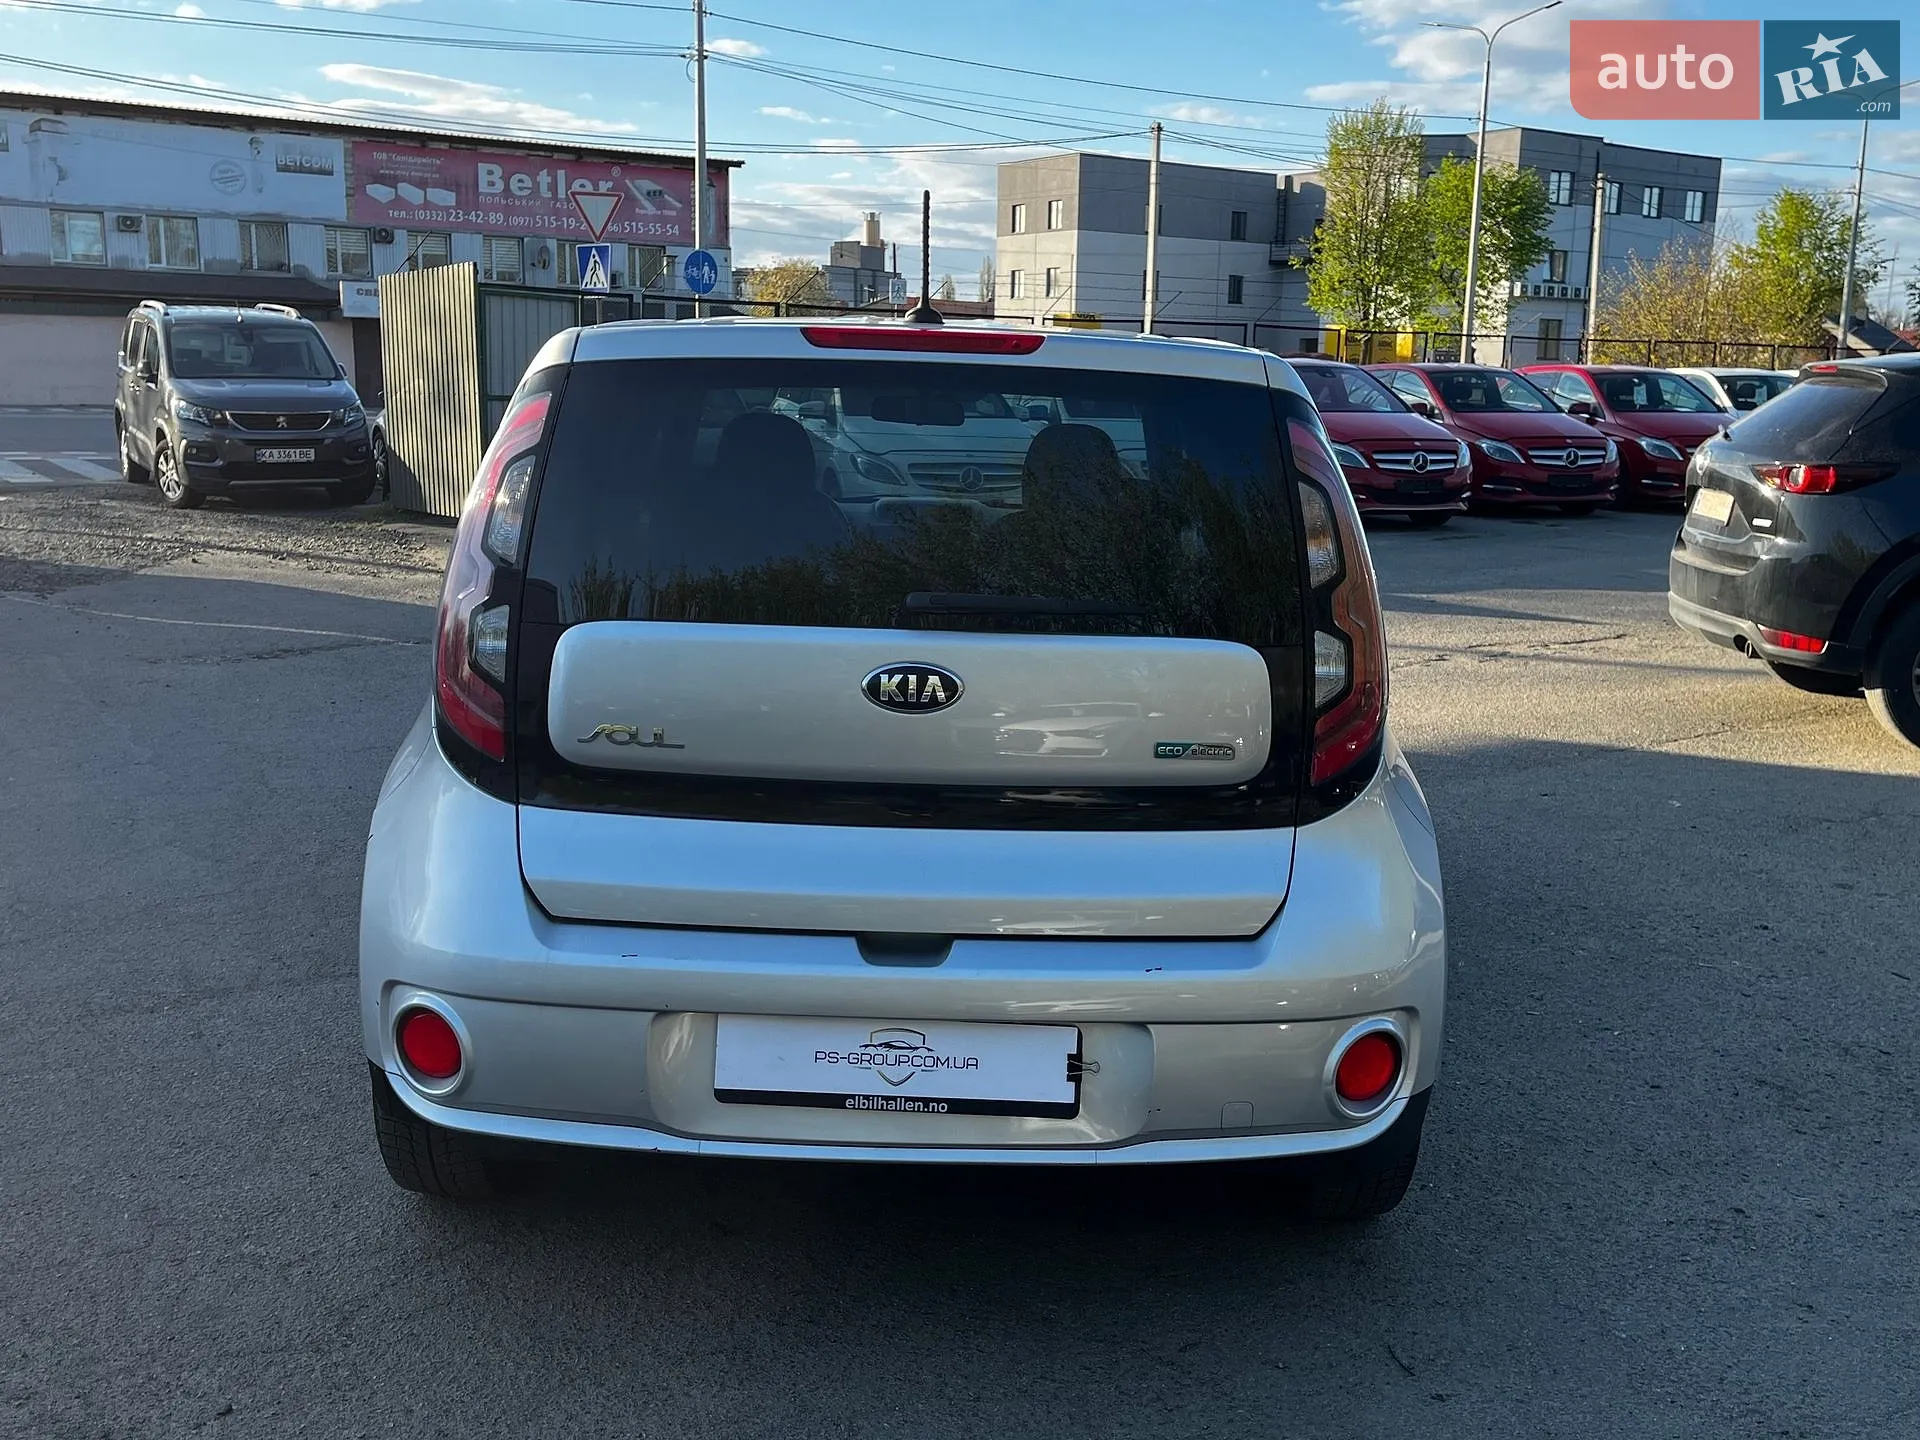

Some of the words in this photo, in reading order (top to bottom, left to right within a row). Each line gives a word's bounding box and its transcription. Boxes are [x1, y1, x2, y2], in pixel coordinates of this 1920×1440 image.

[414, 209, 447, 222] (0332)
[508, 216, 534, 228] (097)
[535, 215, 587, 231] 515-19-2
[623, 220, 680, 236] 515-55-54
[879, 673, 947, 703] KIA
[577, 723, 686, 750] SOUL
[1157, 746, 1183, 755] ECO
[1191, 746, 1233, 757] electric
[813, 1050, 980, 1071] PS-GROUP.COM.UA
[844, 1096, 949, 1114] elbilhallen.no
